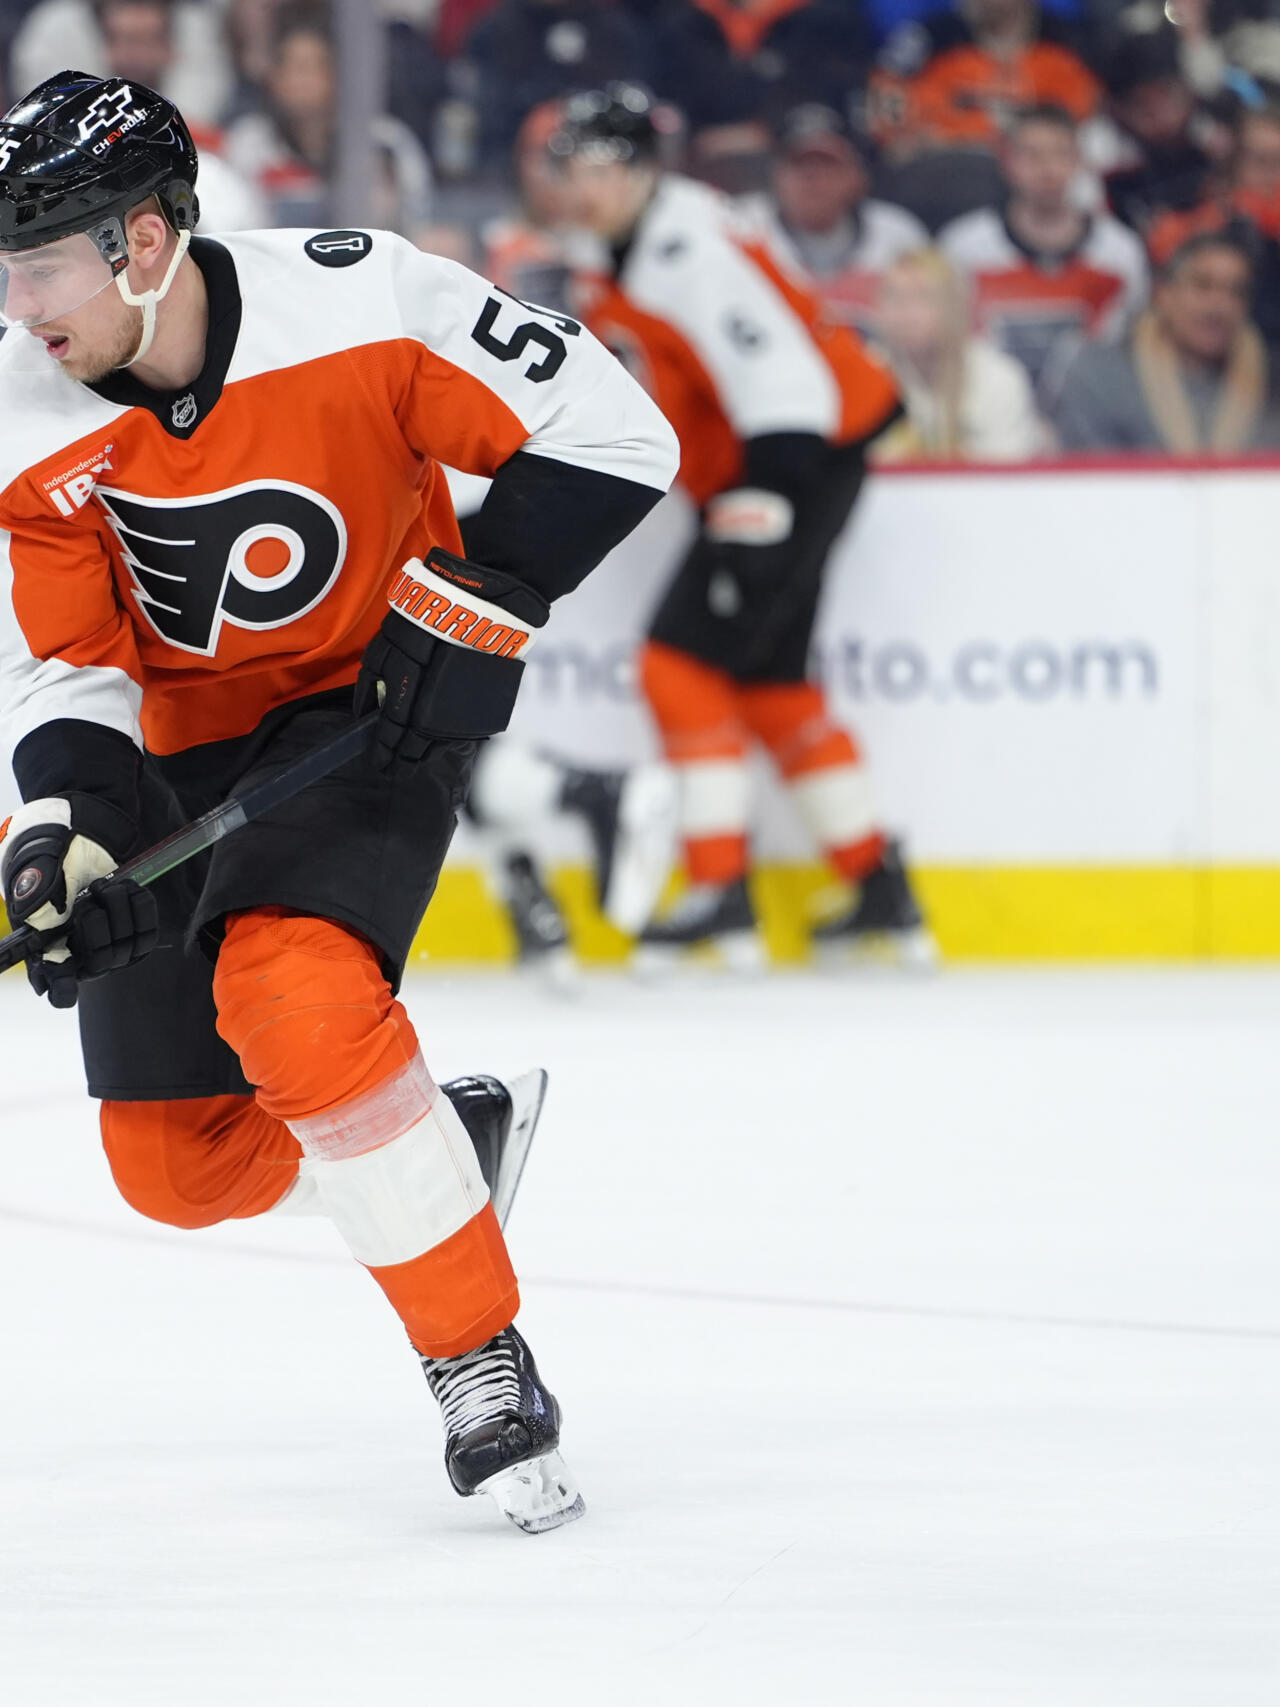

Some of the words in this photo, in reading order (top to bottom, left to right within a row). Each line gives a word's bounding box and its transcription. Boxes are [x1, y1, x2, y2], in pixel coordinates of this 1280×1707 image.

[92, 108, 148, 155] CHEVROLET
[471, 284, 582, 384] 5
[42, 452, 104, 491] Independence
